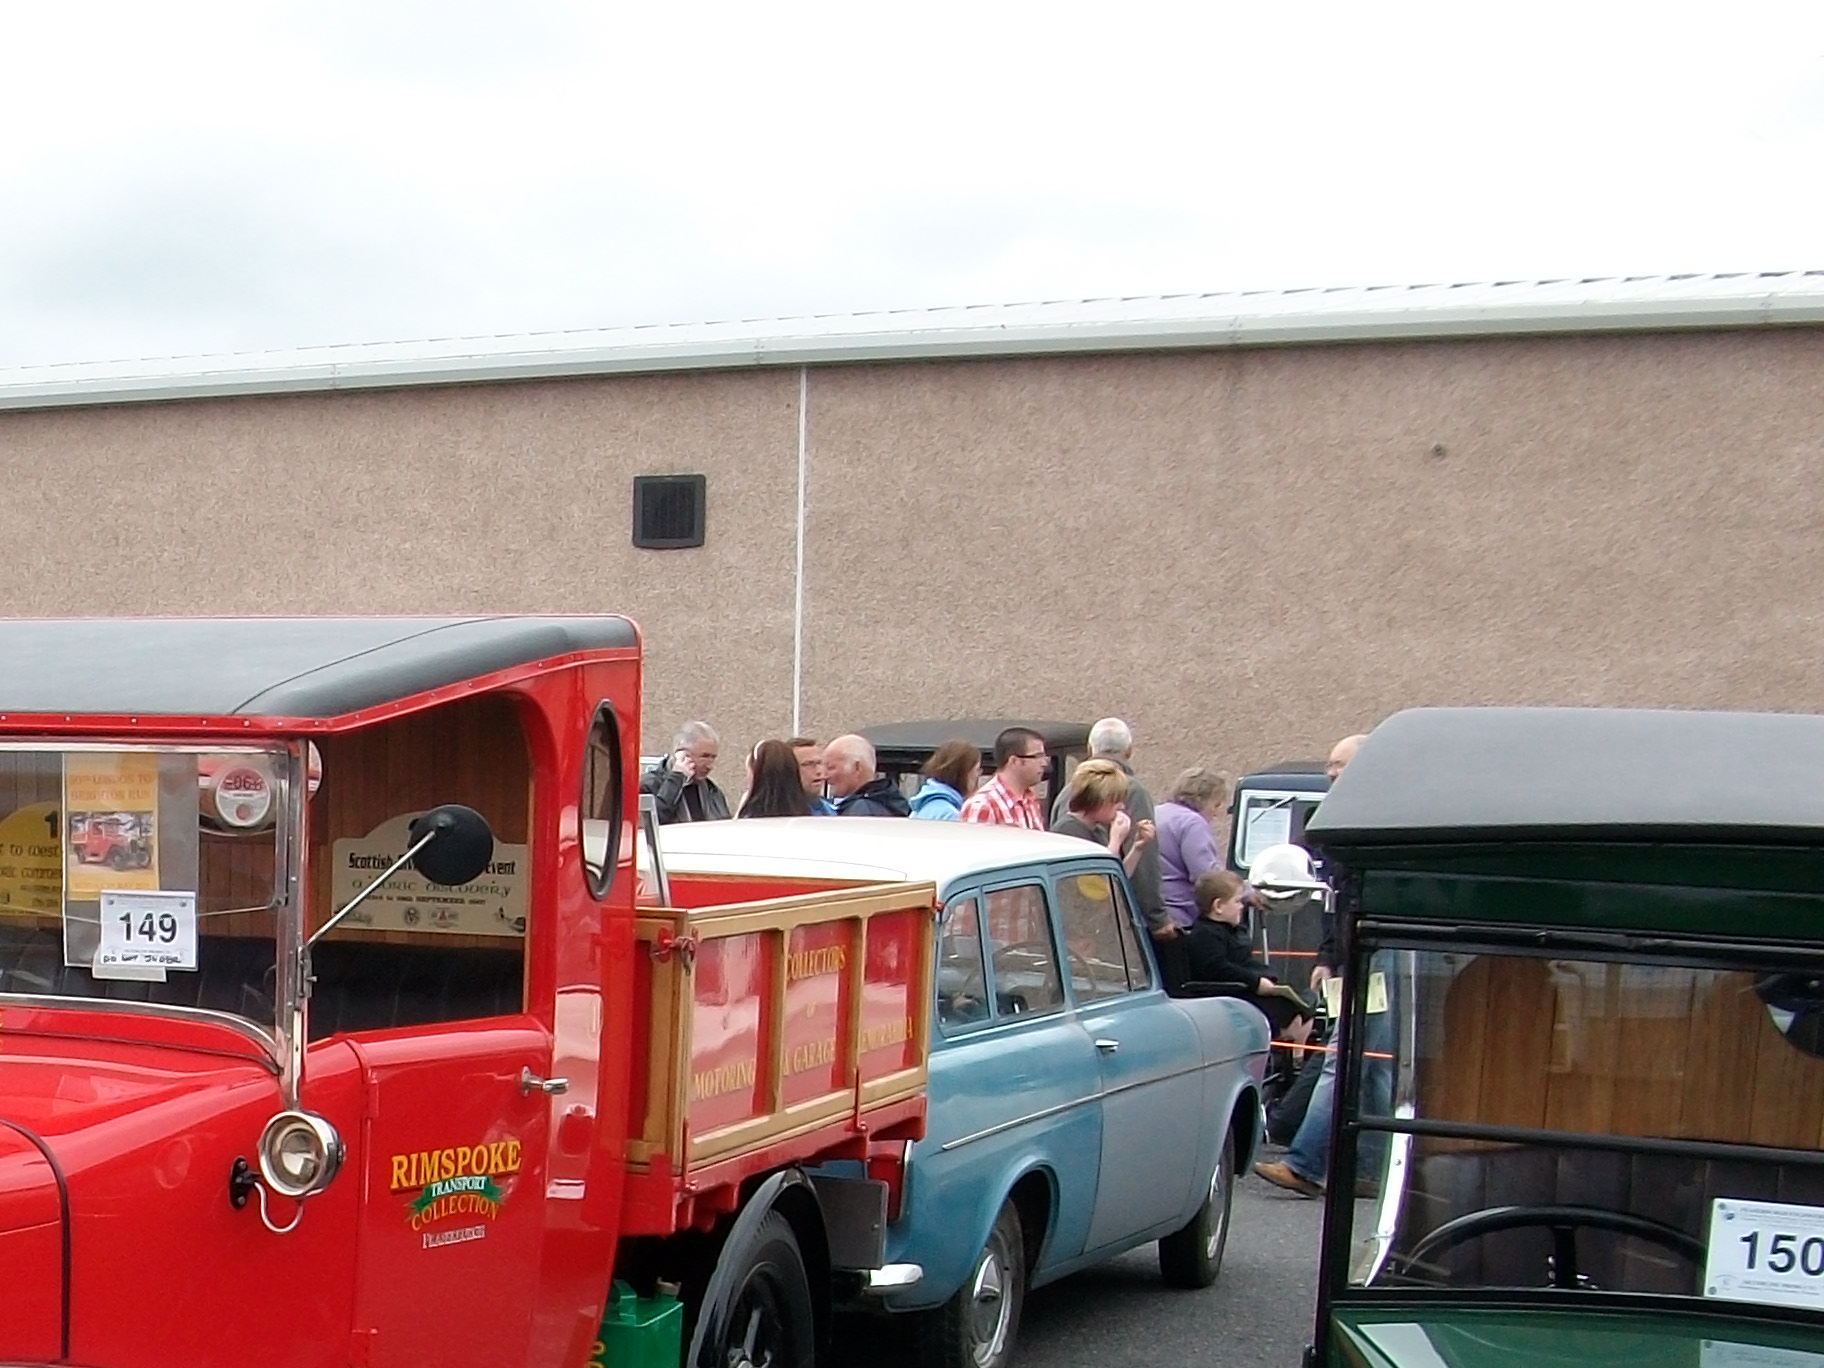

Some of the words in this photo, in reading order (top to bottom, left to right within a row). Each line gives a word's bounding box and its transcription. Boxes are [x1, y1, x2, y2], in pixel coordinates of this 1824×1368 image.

[9, 842, 24, 857] to
[119, 911, 178, 943] 149
[389, 1140, 522, 1190] RIMSPOKE
[430, 1176, 487, 1198] TRANSPORT
[411, 1194, 500, 1231] COLLECTION
[1739, 1231, 1824, 1277] 150
